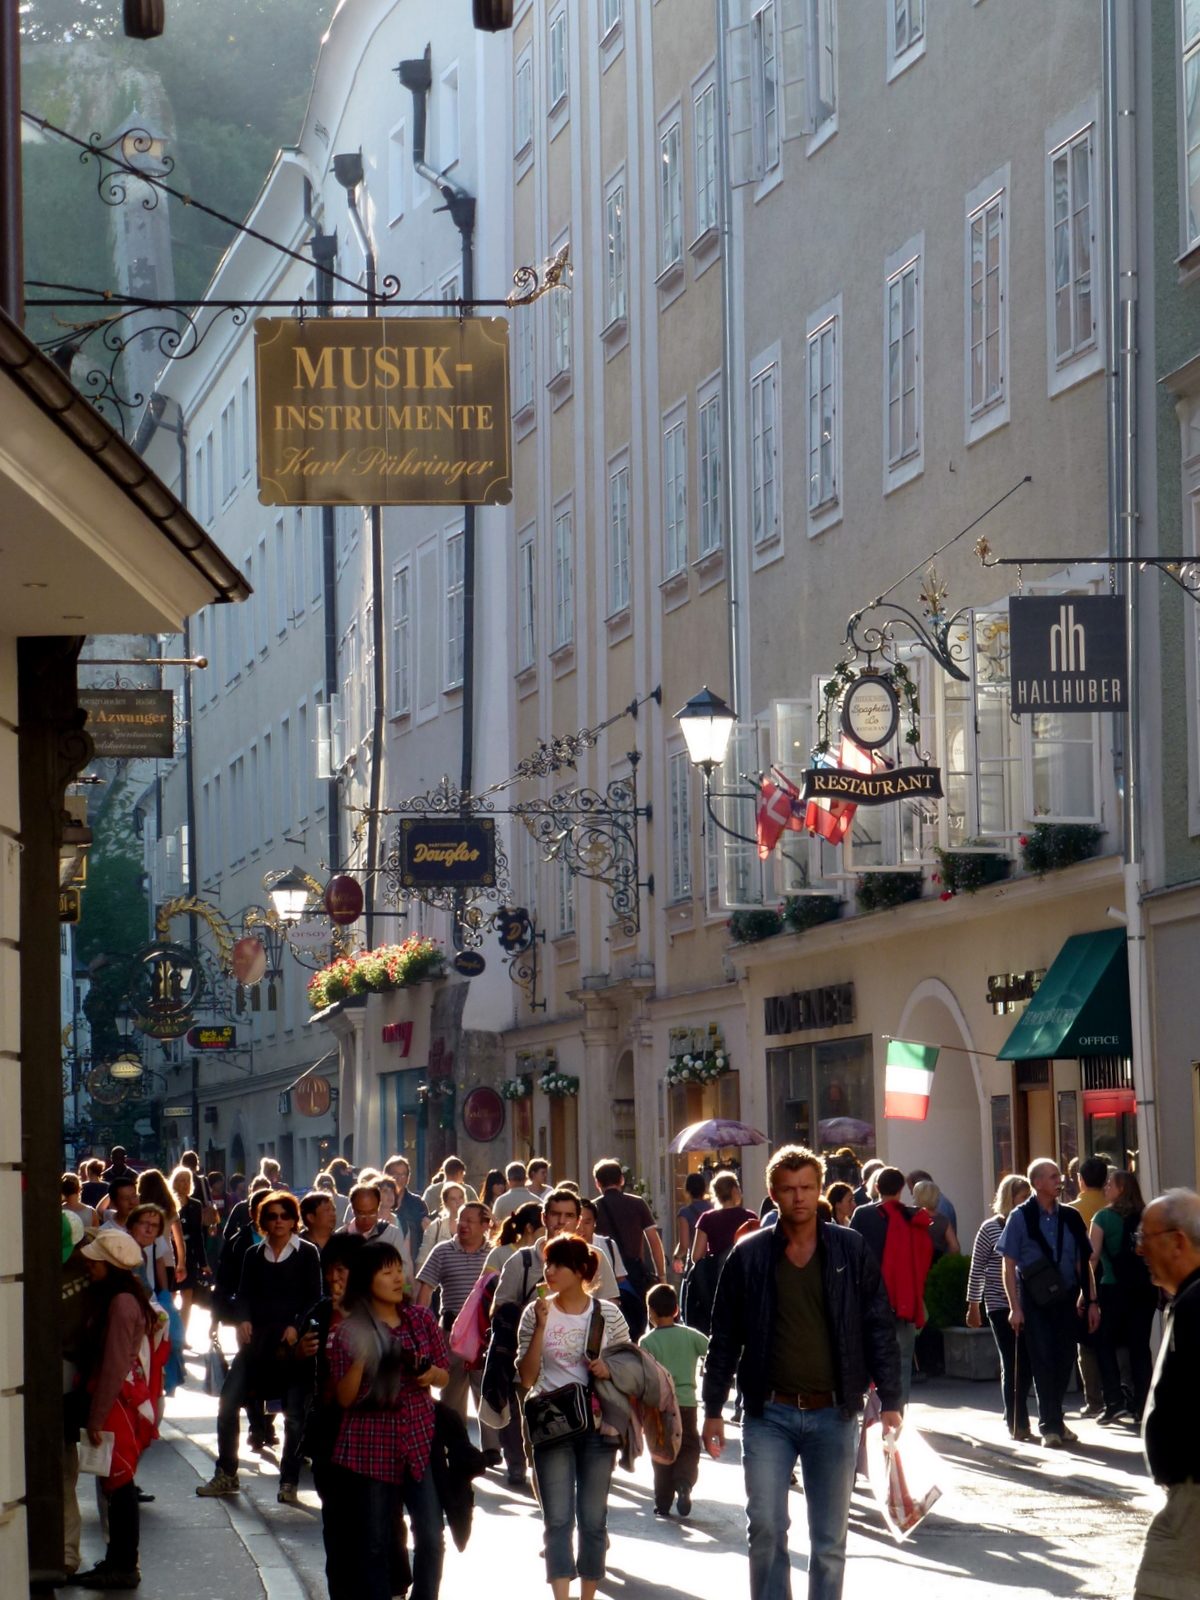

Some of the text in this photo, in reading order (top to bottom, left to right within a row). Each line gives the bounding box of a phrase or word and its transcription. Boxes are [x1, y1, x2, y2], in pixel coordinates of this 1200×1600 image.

[292, 346, 473, 390] MUSIK-
[273, 405, 494, 431] INSTRUMENTE
[275, 446, 495, 486] Karl Pühringer
[1018, 679, 1121, 704] HALLHUBER
[96, 709, 167, 726] Azwanger
[814, 774, 934, 796] RESTAURANT
[412, 841, 480, 867] Douglas
[1078, 1036, 1120, 1045] OFFICE
